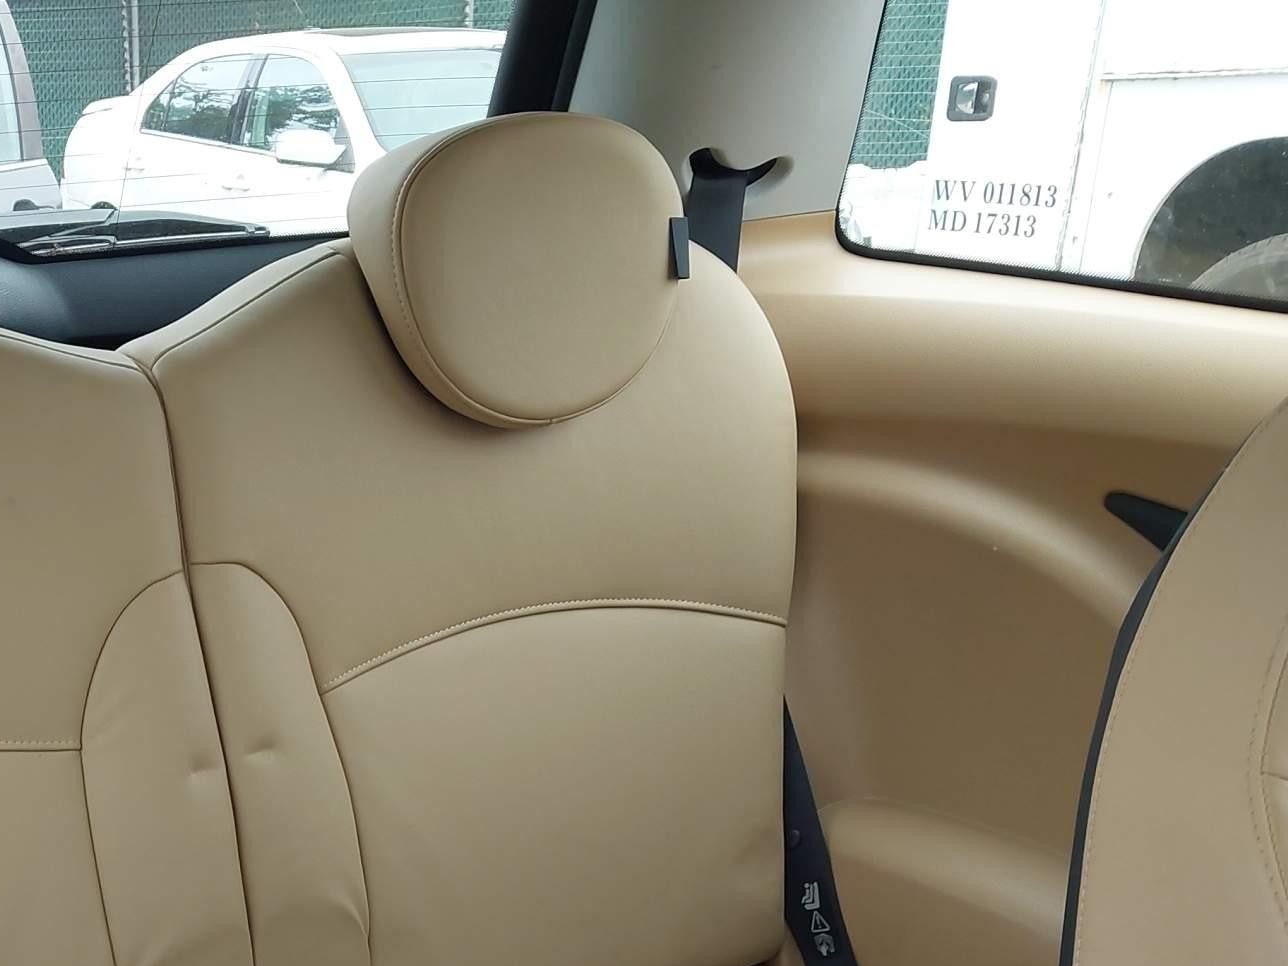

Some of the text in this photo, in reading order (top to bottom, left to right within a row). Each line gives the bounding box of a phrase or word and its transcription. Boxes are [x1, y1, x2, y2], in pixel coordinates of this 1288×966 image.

[934, 179, 1058, 208] WV 011813
[928, 208, 1037, 238] MD 17313
